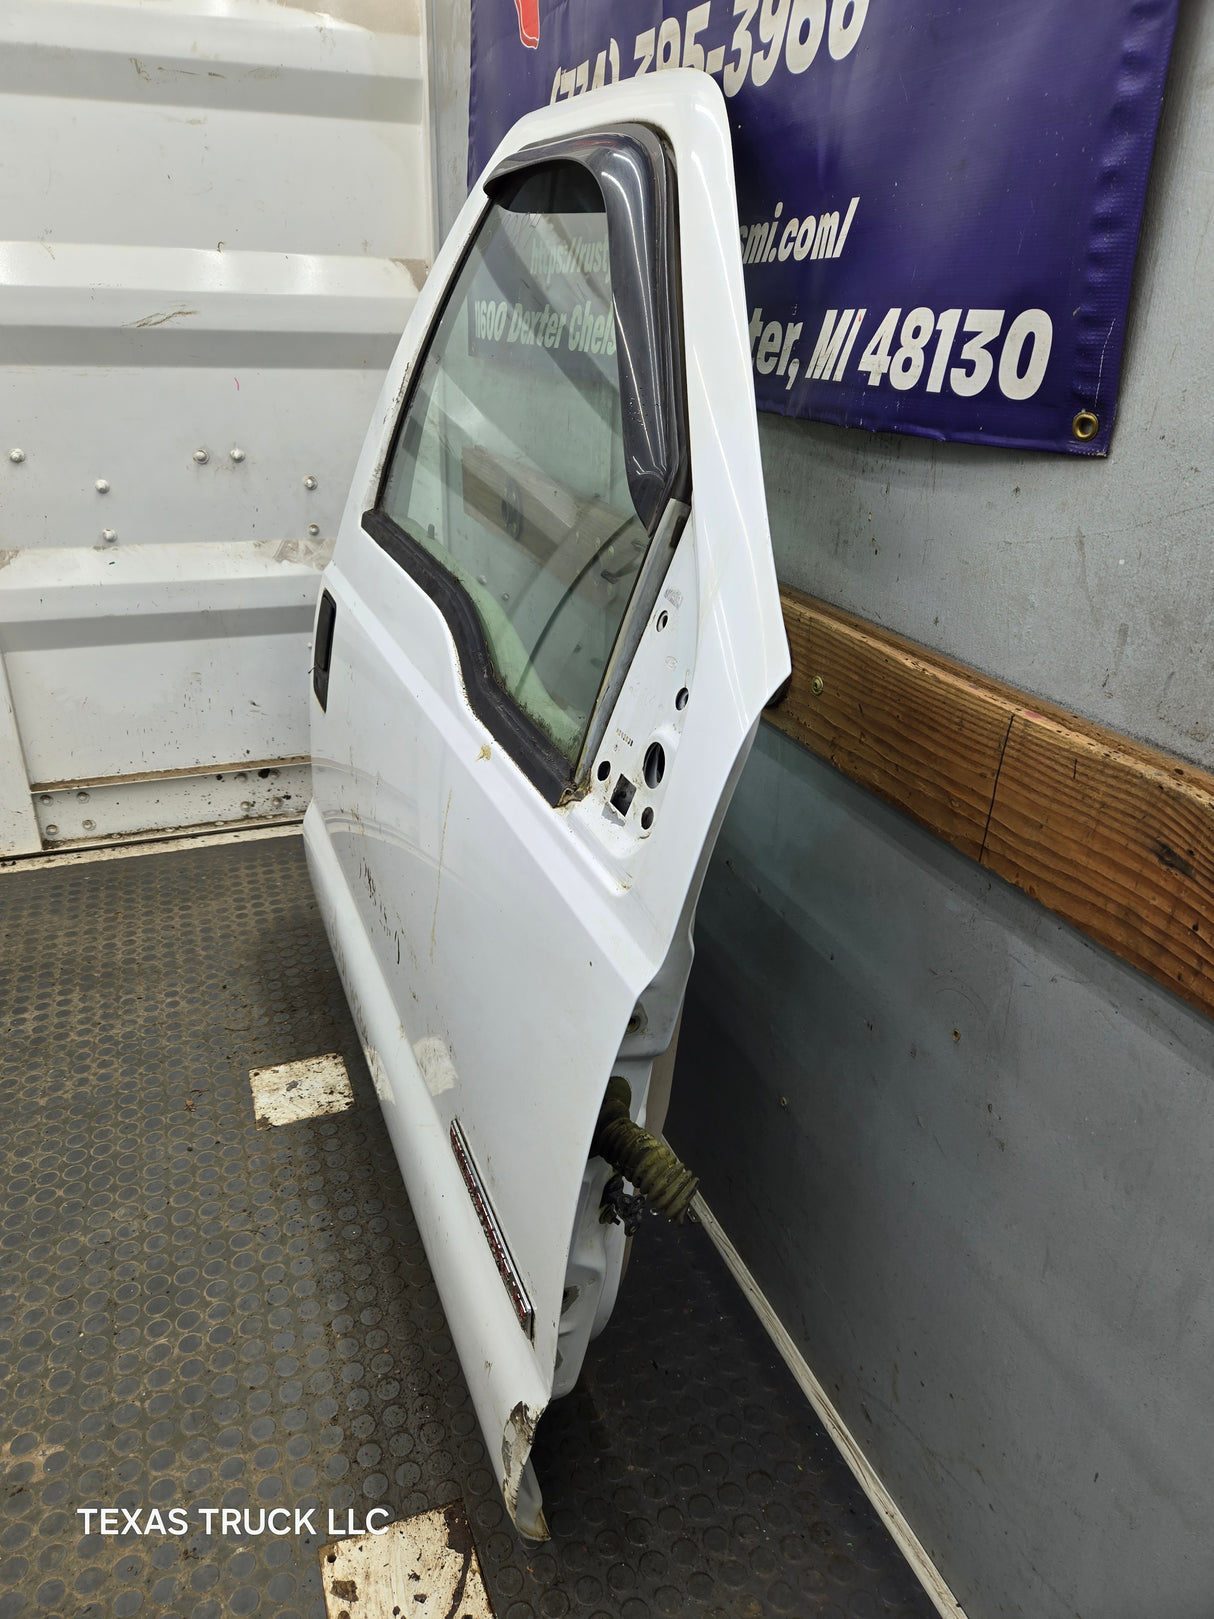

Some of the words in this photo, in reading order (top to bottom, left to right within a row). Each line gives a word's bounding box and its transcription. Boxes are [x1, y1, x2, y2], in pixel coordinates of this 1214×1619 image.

[506, 302, 568, 349] Dexter
[805, 309, 867, 382] MI
[857, 306, 1053, 400] 48130
